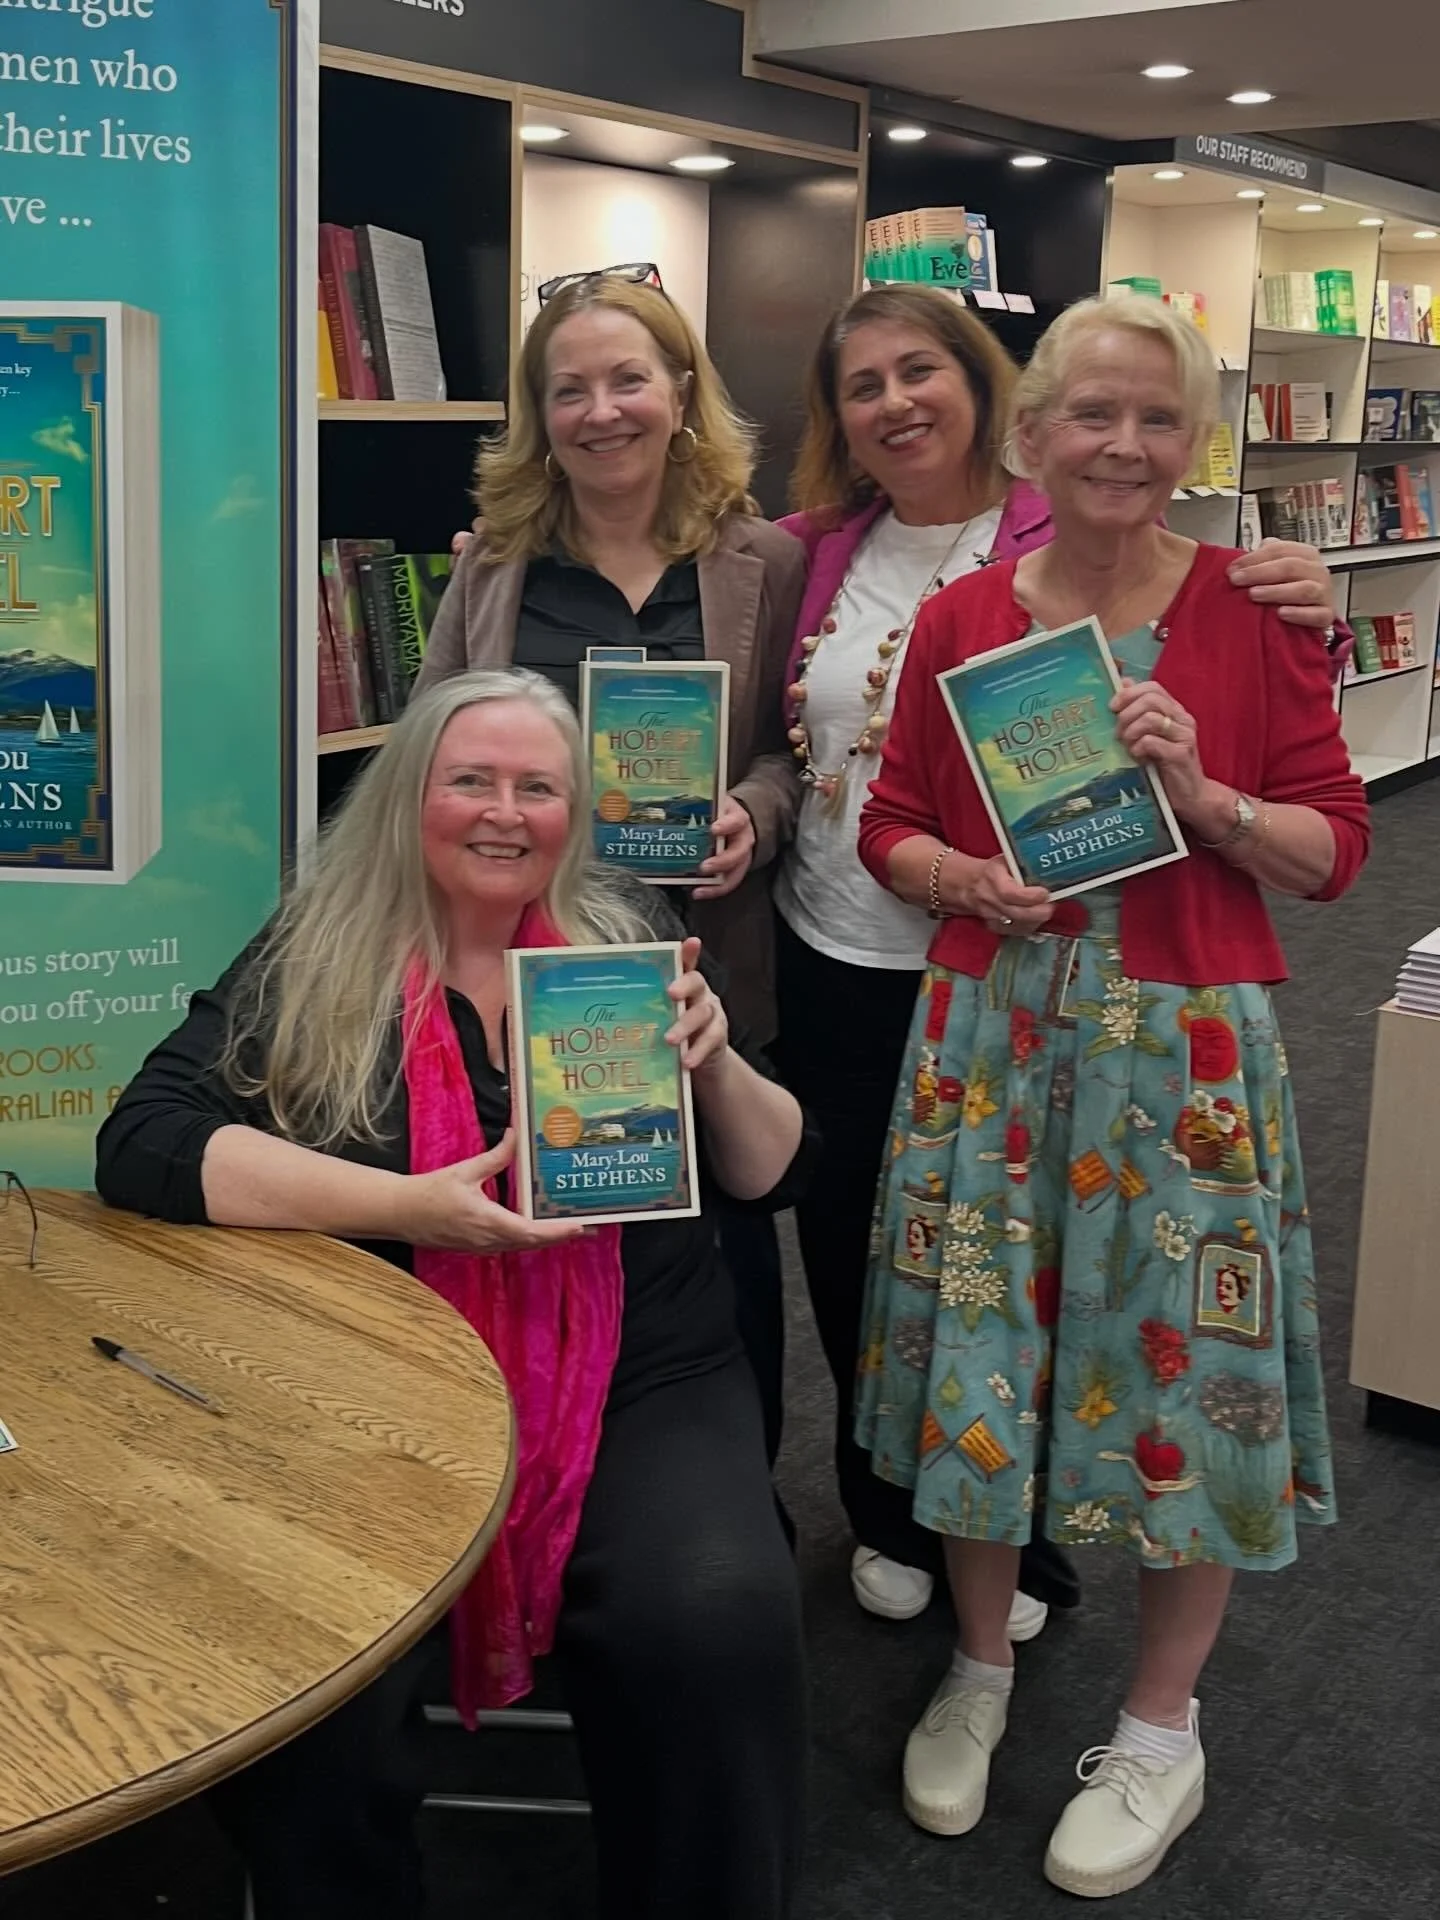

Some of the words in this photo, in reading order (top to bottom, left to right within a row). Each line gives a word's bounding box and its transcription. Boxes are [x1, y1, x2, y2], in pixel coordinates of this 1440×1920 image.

[90, 49, 178, 92] who
[0, 112, 91, 156] heir
[100, 118, 191, 163] lives
[1196, 135, 1218, 157] OUR
[1220, 141, 1250, 165] STAFF
[1250, 149, 1308, 180] RECOMMEND
[930, 256, 968, 281] Eve
[392, 564, 425, 675] MORIYAMA
[993, 695, 1097, 753] HOBART
[1016, 735, 1103, 780] HOTEL
[17, 819, 73, 830] AUTHOR
[619, 827, 685, 844] Mary-Lou
[1047, 814, 1123, 846] Mary-Lou
[605, 843, 698, 857] STEPHENS
[1040, 823, 1145, 868] STEPHENS
[0, 955, 37, 976] us
[44, 949, 122, 977] story
[127, 937, 182, 967] will
[46, 989, 94, 1020] off
[93, 994, 164, 1025] your
[550, 1023, 659, 1055] HOBART
[0, 1043, 102, 1079] OOKS.
[562, 1060, 651, 1091] HOTEL
[556, 1167, 667, 1190] STEPHENS
[571, 1150, 650, 1171] Mary-Lou
